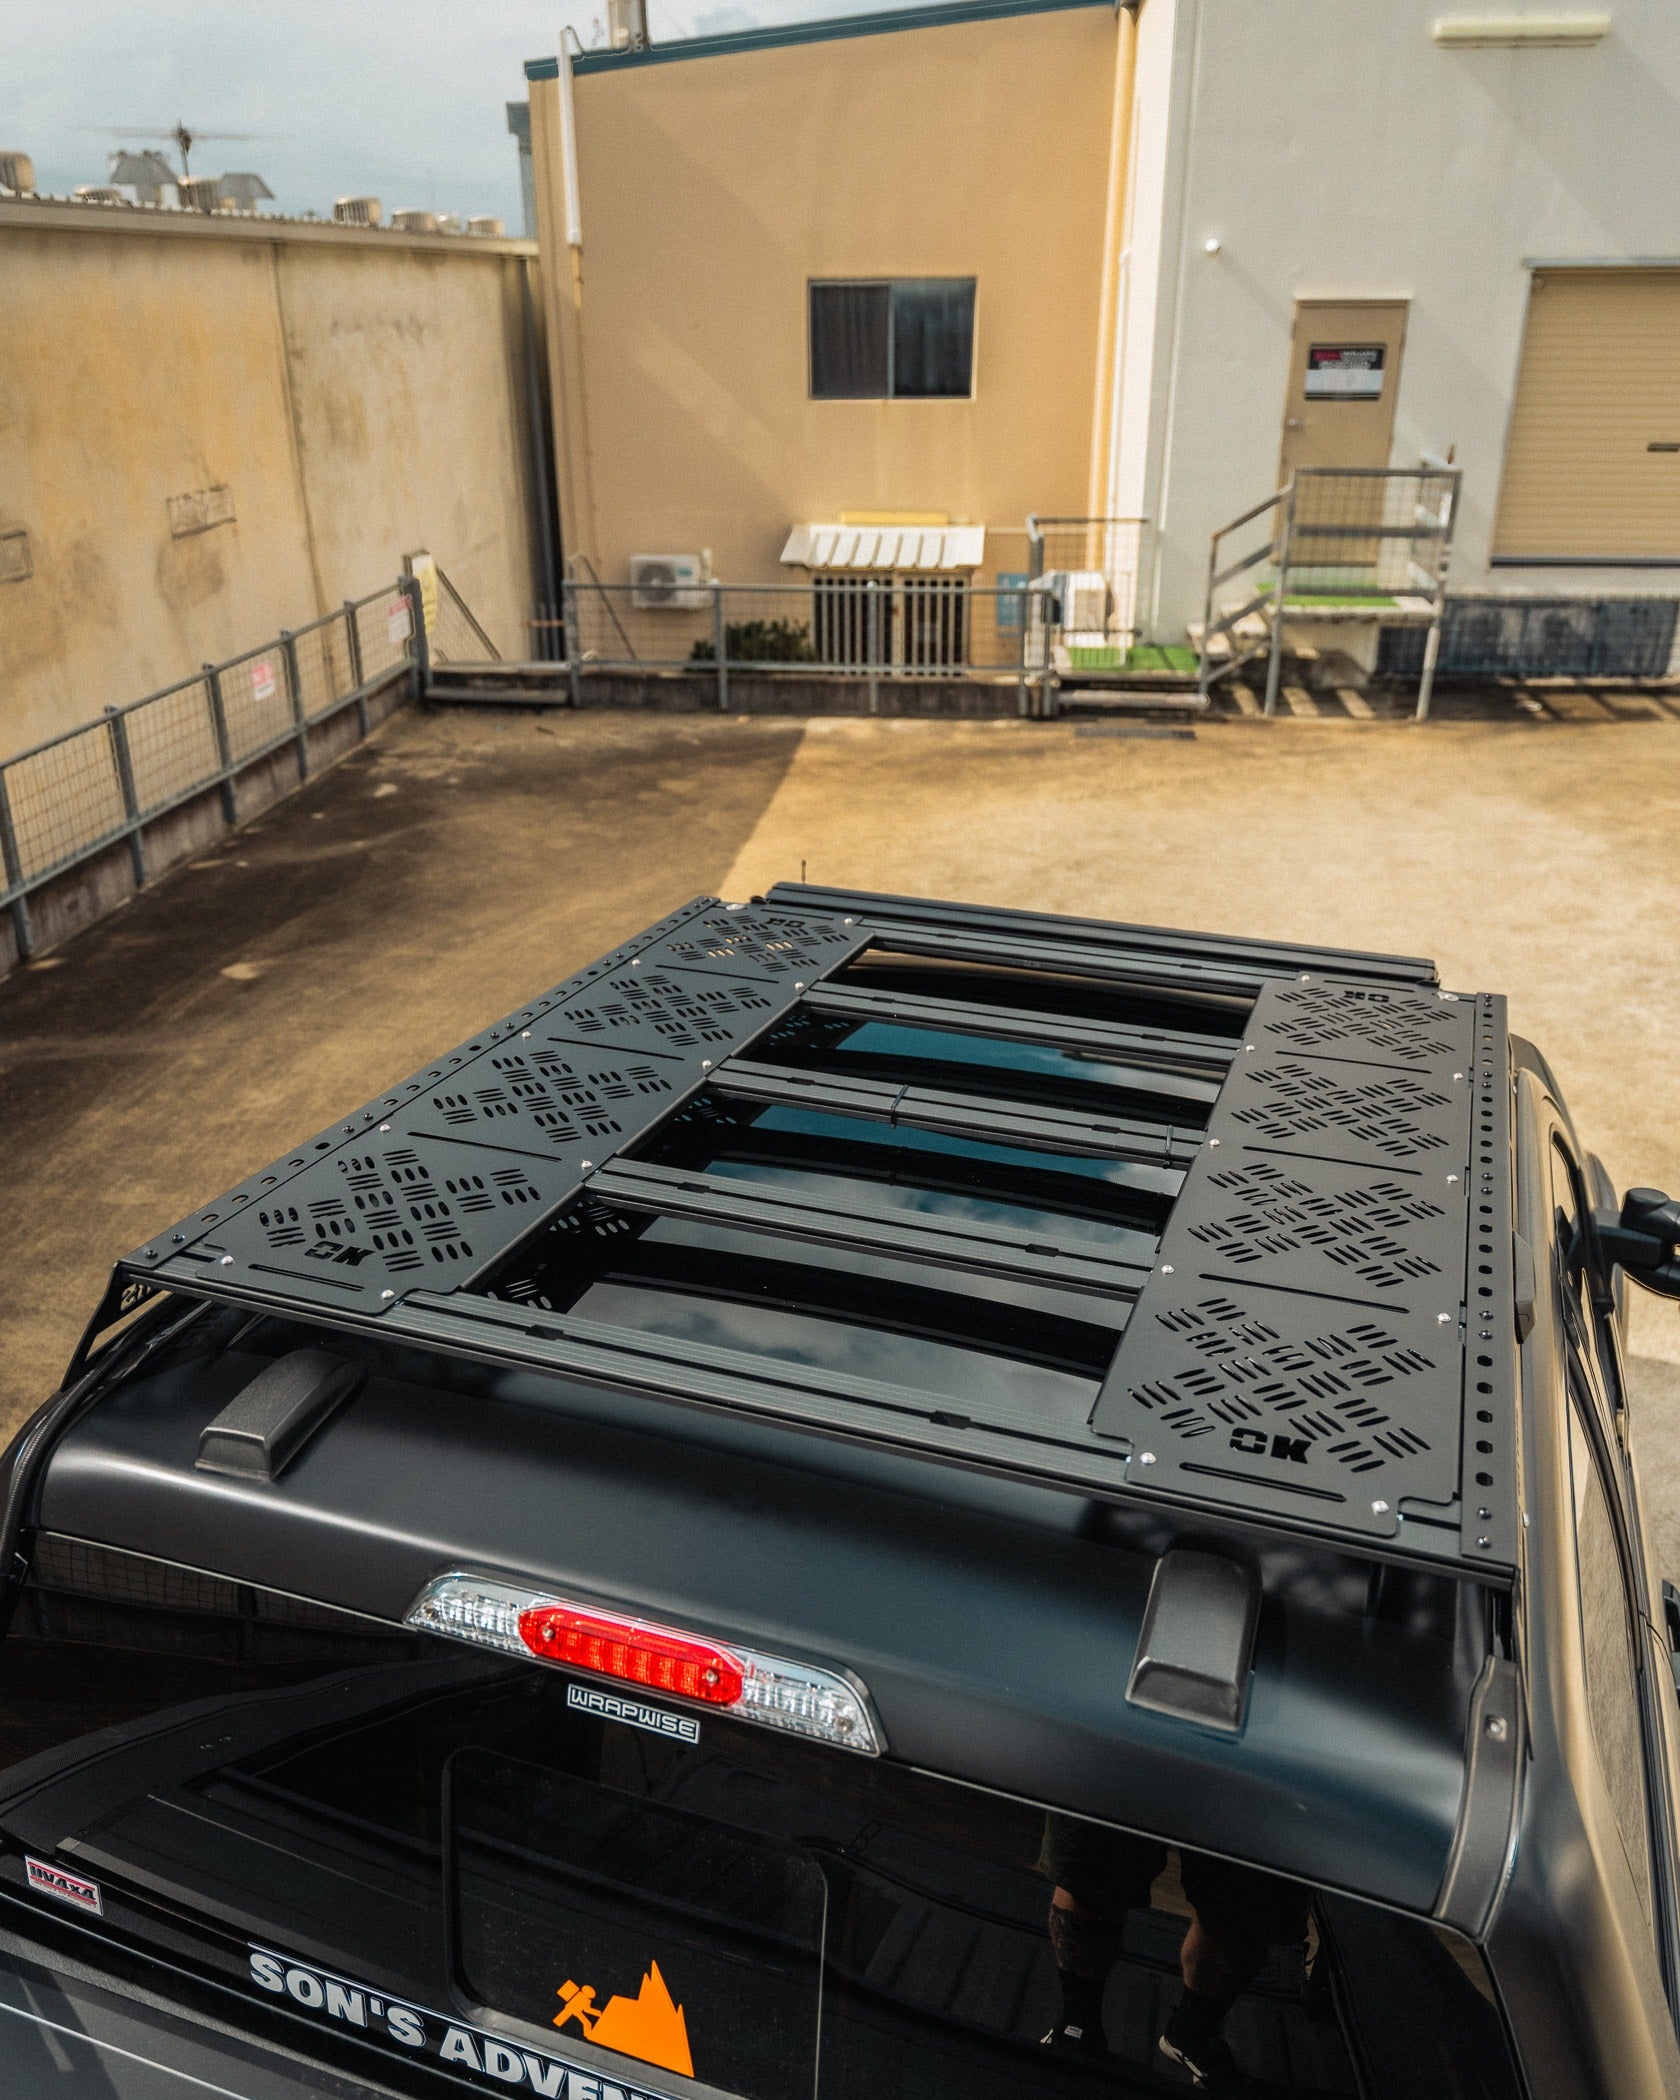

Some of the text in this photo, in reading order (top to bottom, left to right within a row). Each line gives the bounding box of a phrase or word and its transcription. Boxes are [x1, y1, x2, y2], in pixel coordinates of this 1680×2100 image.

[304, 1240, 375, 1267] OK
[1230, 1427, 1312, 1465] OK
[571, 1688, 695, 1737] WRAPWISE
[249, 1952, 427, 2048] SON'S
